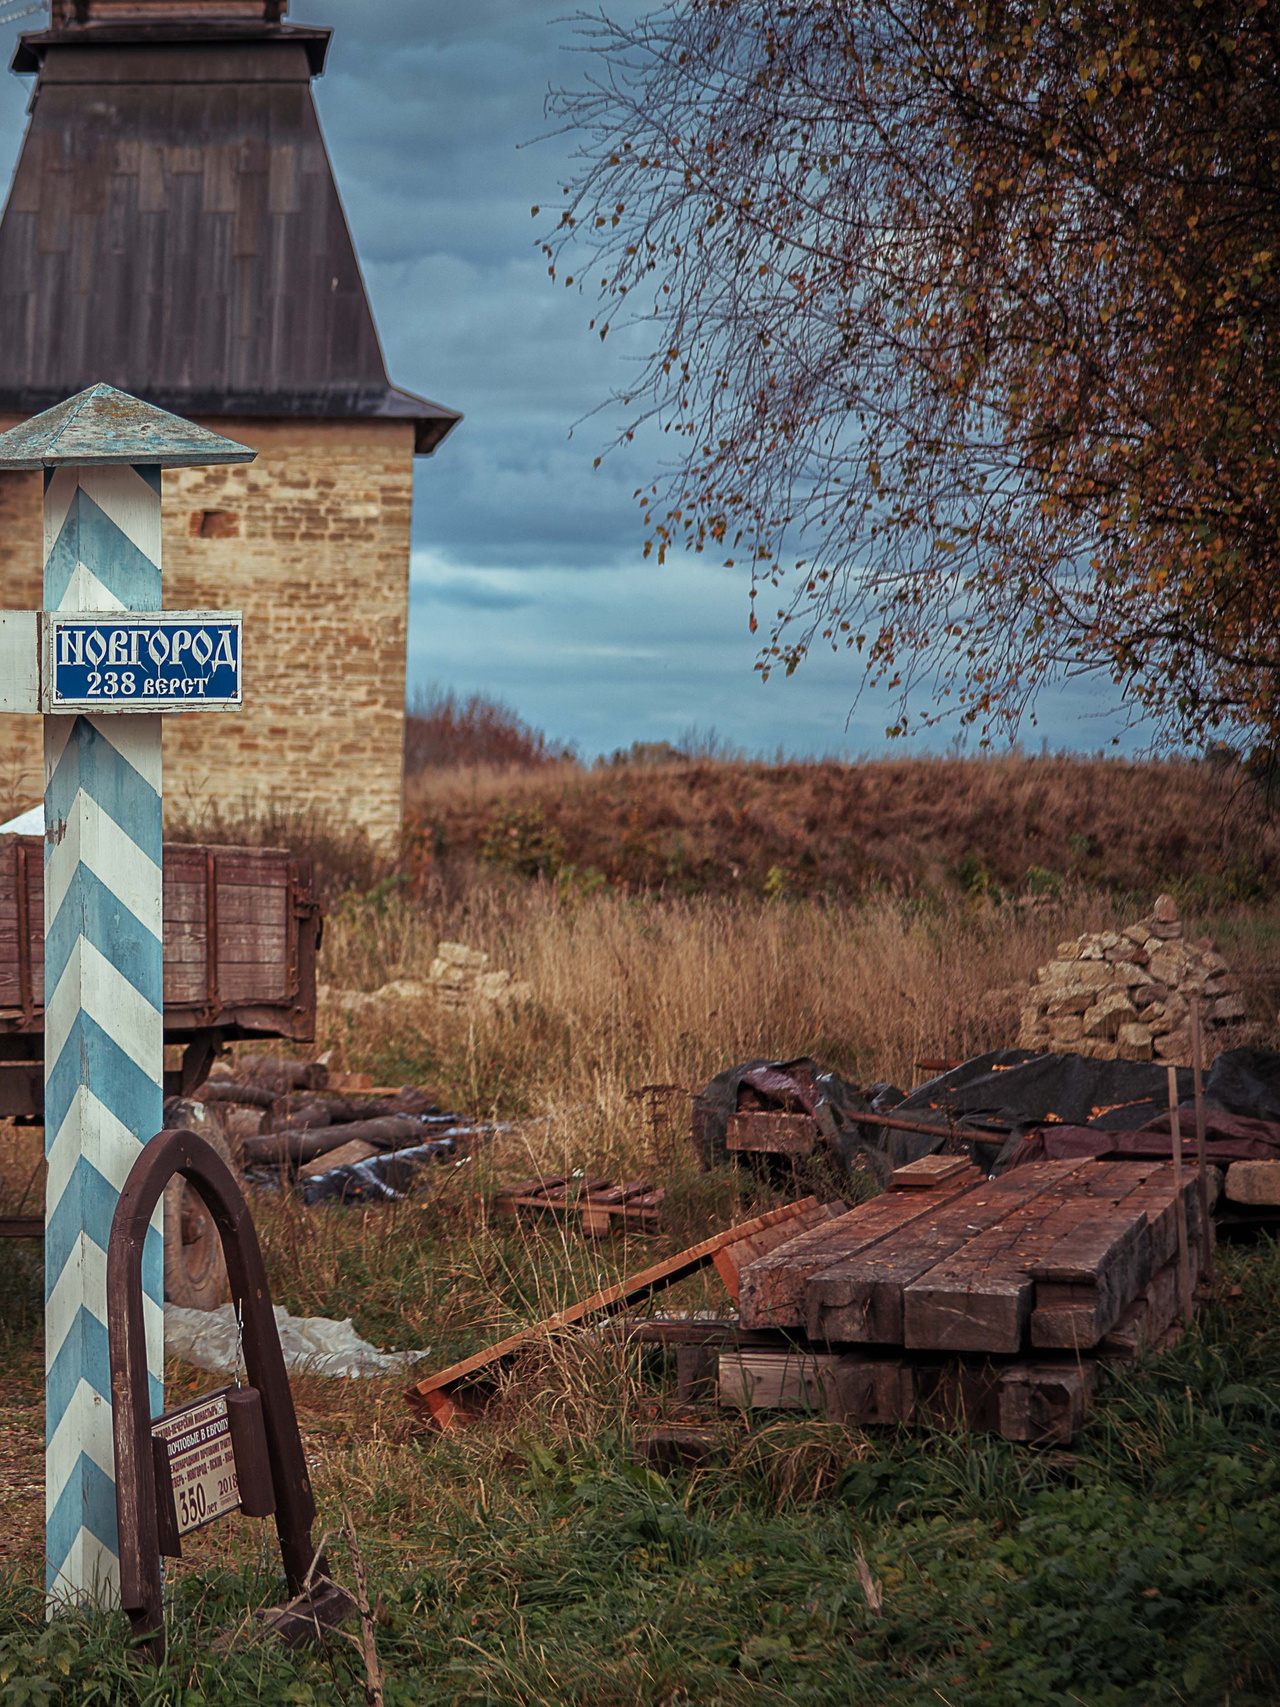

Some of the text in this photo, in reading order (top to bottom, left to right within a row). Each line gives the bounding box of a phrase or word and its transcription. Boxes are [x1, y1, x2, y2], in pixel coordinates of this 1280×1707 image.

[56, 628, 237, 673] НОВГОРОД
[86, 671, 137, 696] 238
[167, 1417, 229, 1456] ПОЧТОВЫЕ В ЕВРОПУ
[217, 1472, 238, 1496] 2018
[179, 1482, 206, 1527] 350
[206, 1501, 218, 1515] лет
